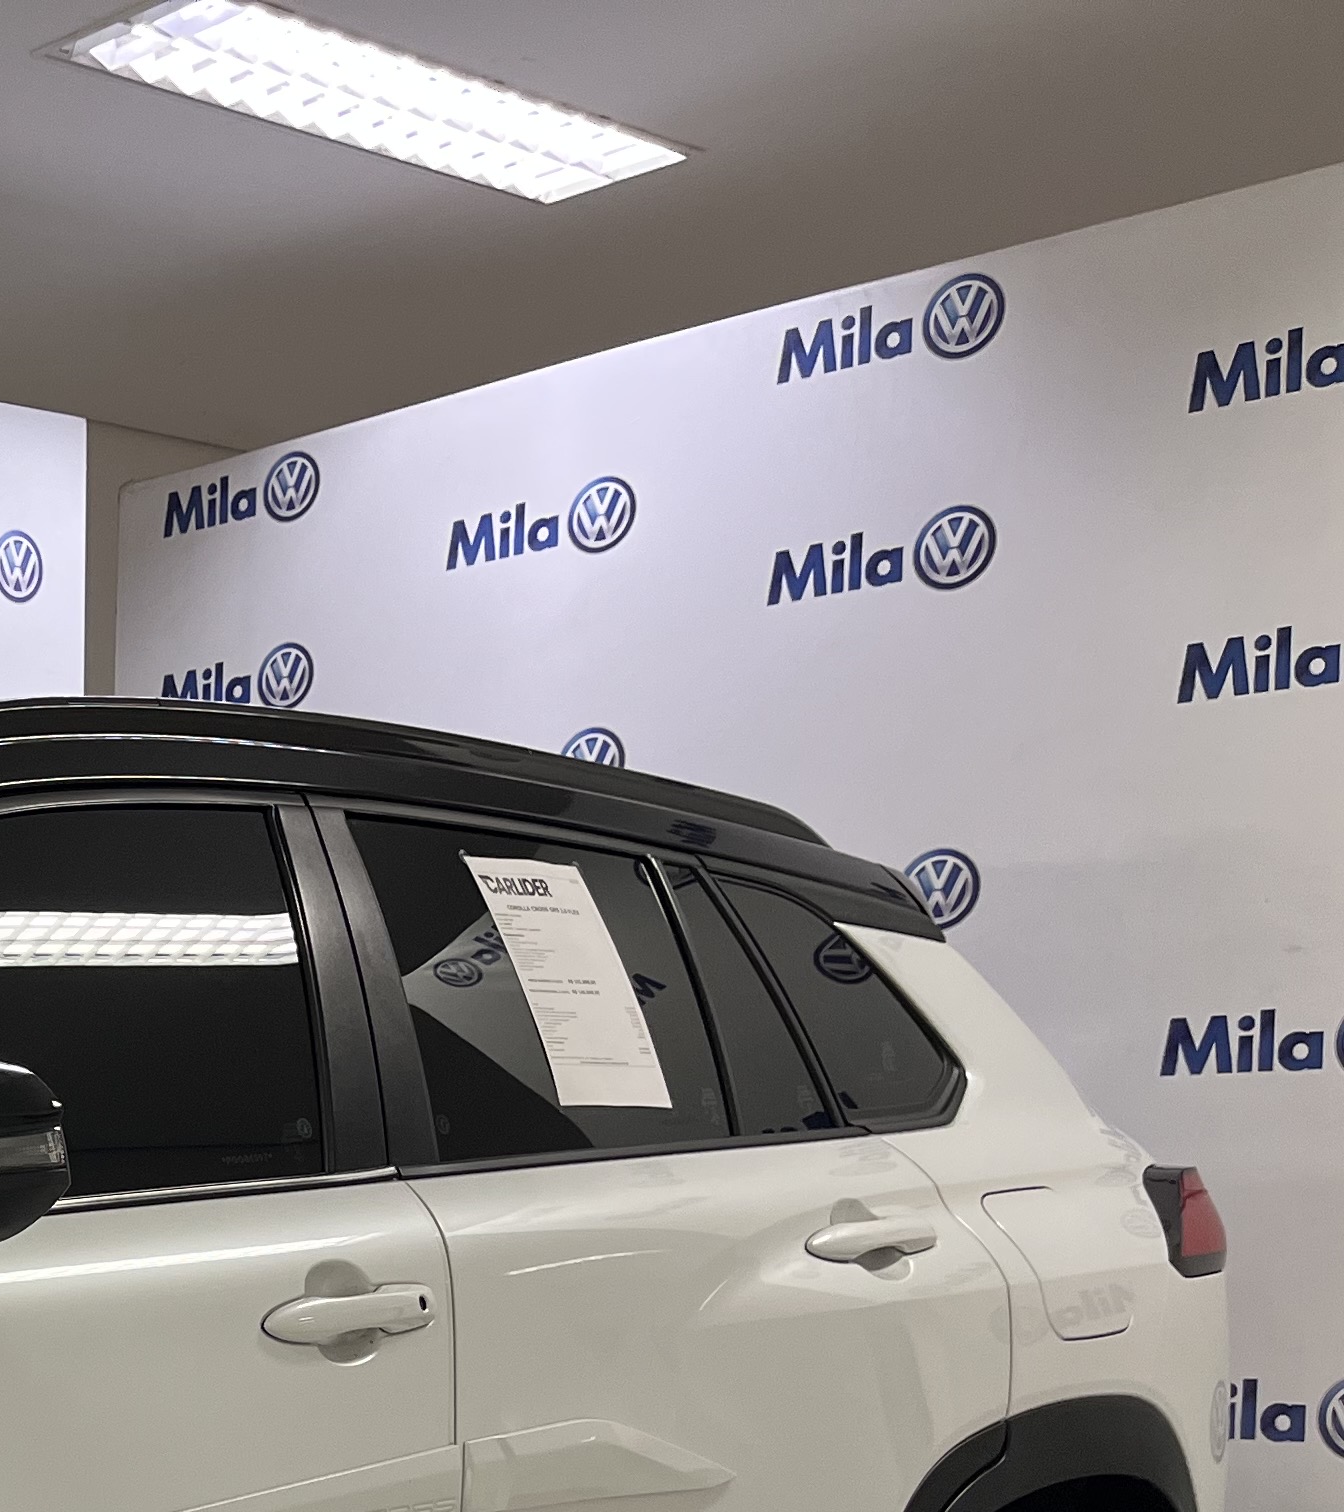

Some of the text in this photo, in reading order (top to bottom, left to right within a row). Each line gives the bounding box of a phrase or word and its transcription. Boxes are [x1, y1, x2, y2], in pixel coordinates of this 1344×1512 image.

[777, 279, 1000, 385] Mila VW
[1188, 327, 1344, 413] Mila
[164, 456, 316, 538] Mila VW
[446, 481, 631, 571] Mila VW
[767, 511, 990, 606] Mila VW
[261, 647, 310, 703] VW
[1177, 626, 1340, 704] Mila
[477, 874, 553, 898] CARLIDER
[1160, 1009, 1324, 1076] Mila
